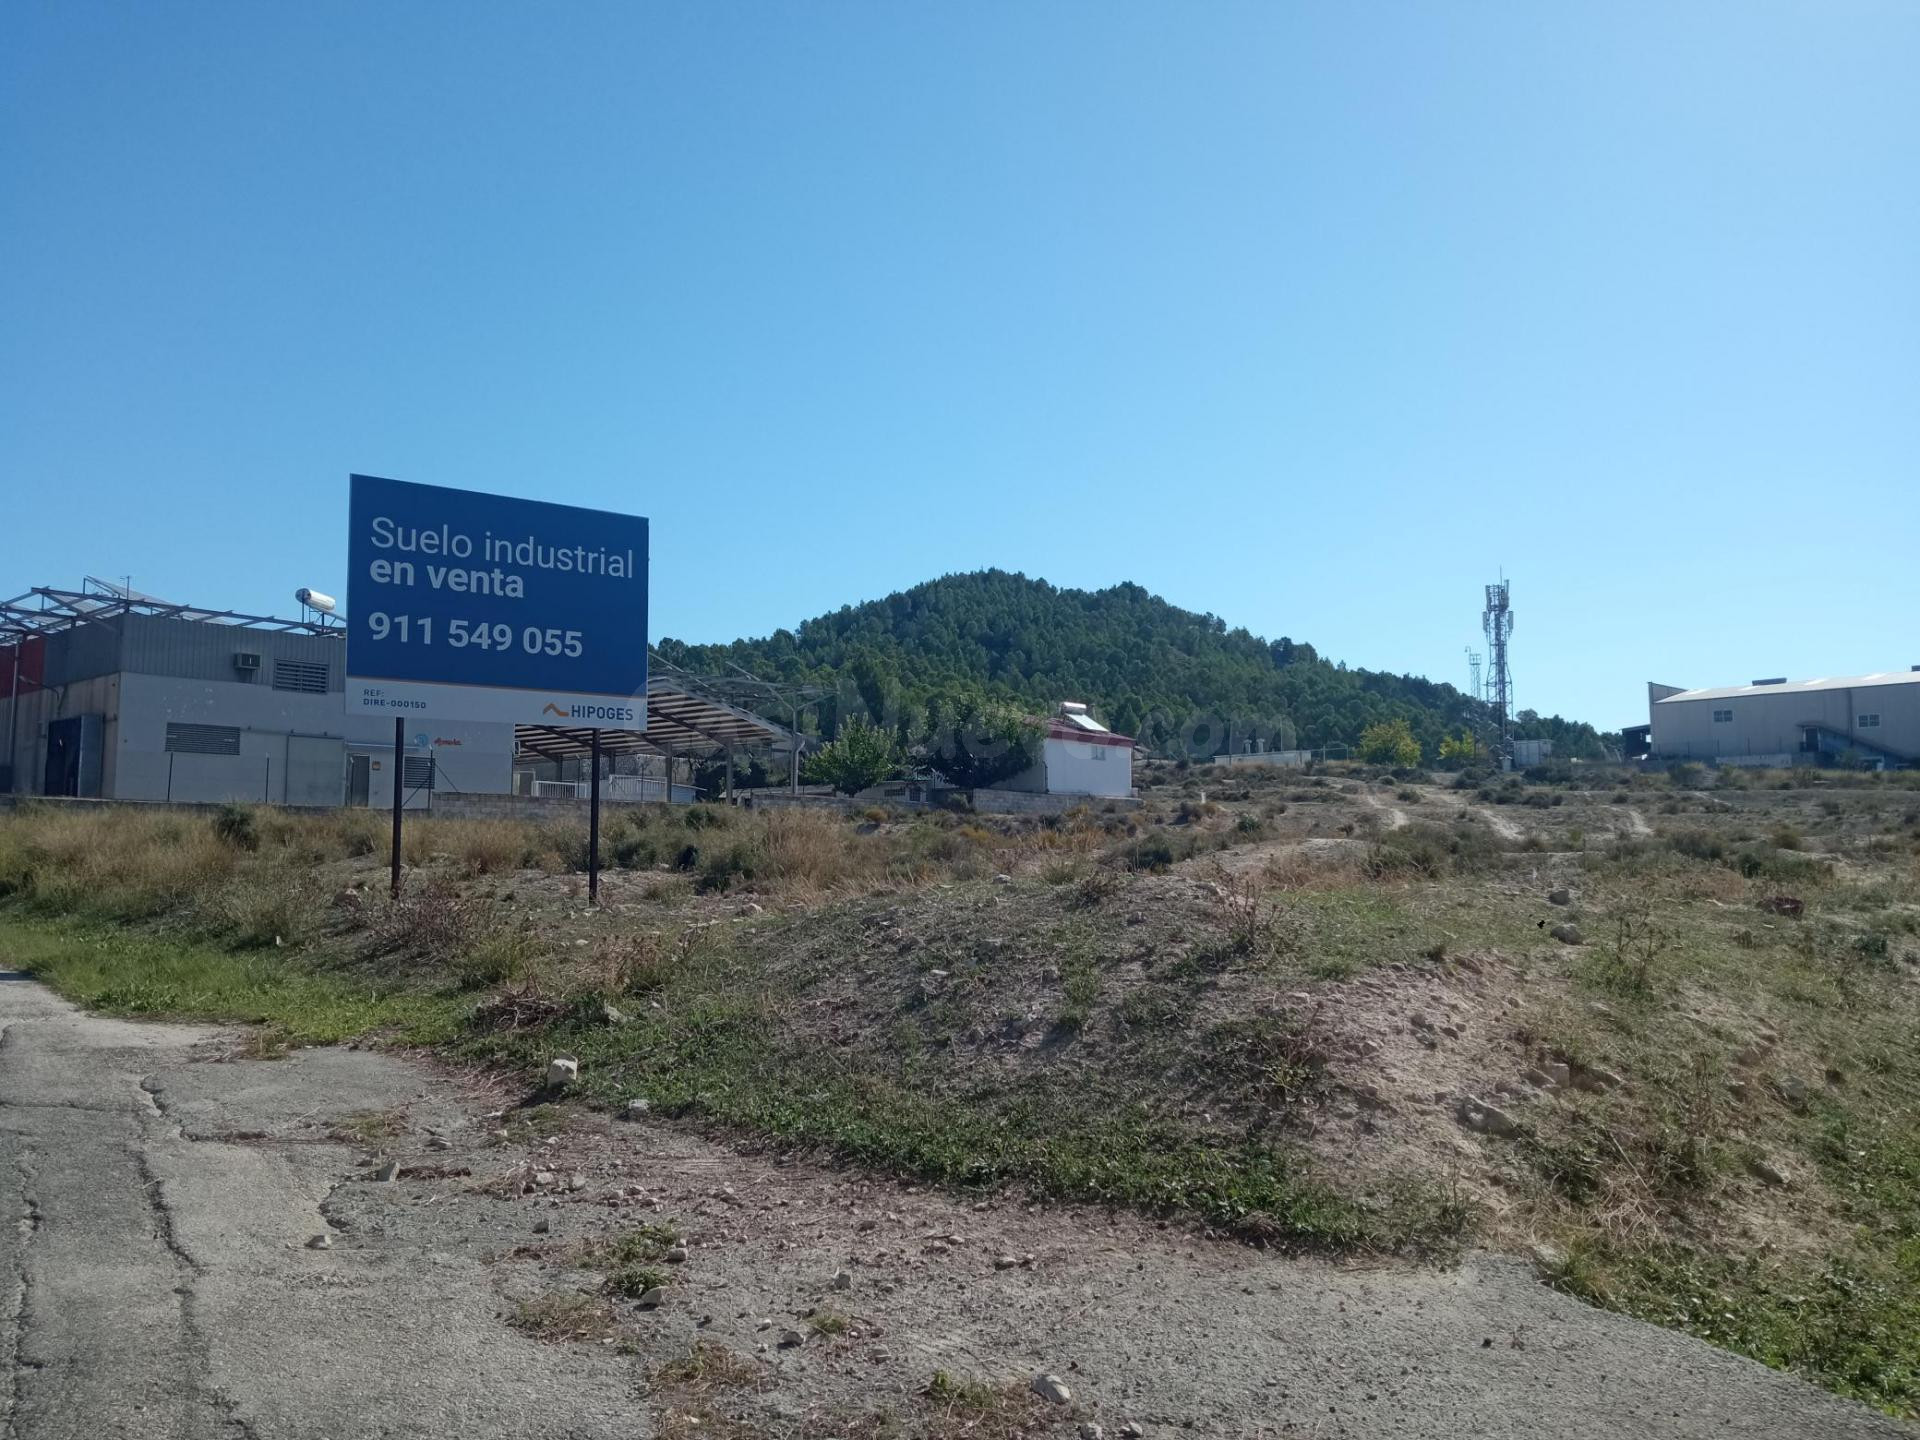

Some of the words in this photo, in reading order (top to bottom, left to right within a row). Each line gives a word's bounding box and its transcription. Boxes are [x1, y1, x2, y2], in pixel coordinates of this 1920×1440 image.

[370, 516, 472, 558] Suelo
[485, 531, 633, 579] industrial
[370, 559, 415, 586] en
[427, 565, 524, 599] venta
[368, 611, 432, 645] 911
[448, 619, 512, 651] 549
[523, 627, 583, 658] 055
[363, 688, 385, 697] REF:
[363, 698, 427, 709] DIRE-000150
[571, 704, 634, 721] HIPOGES
